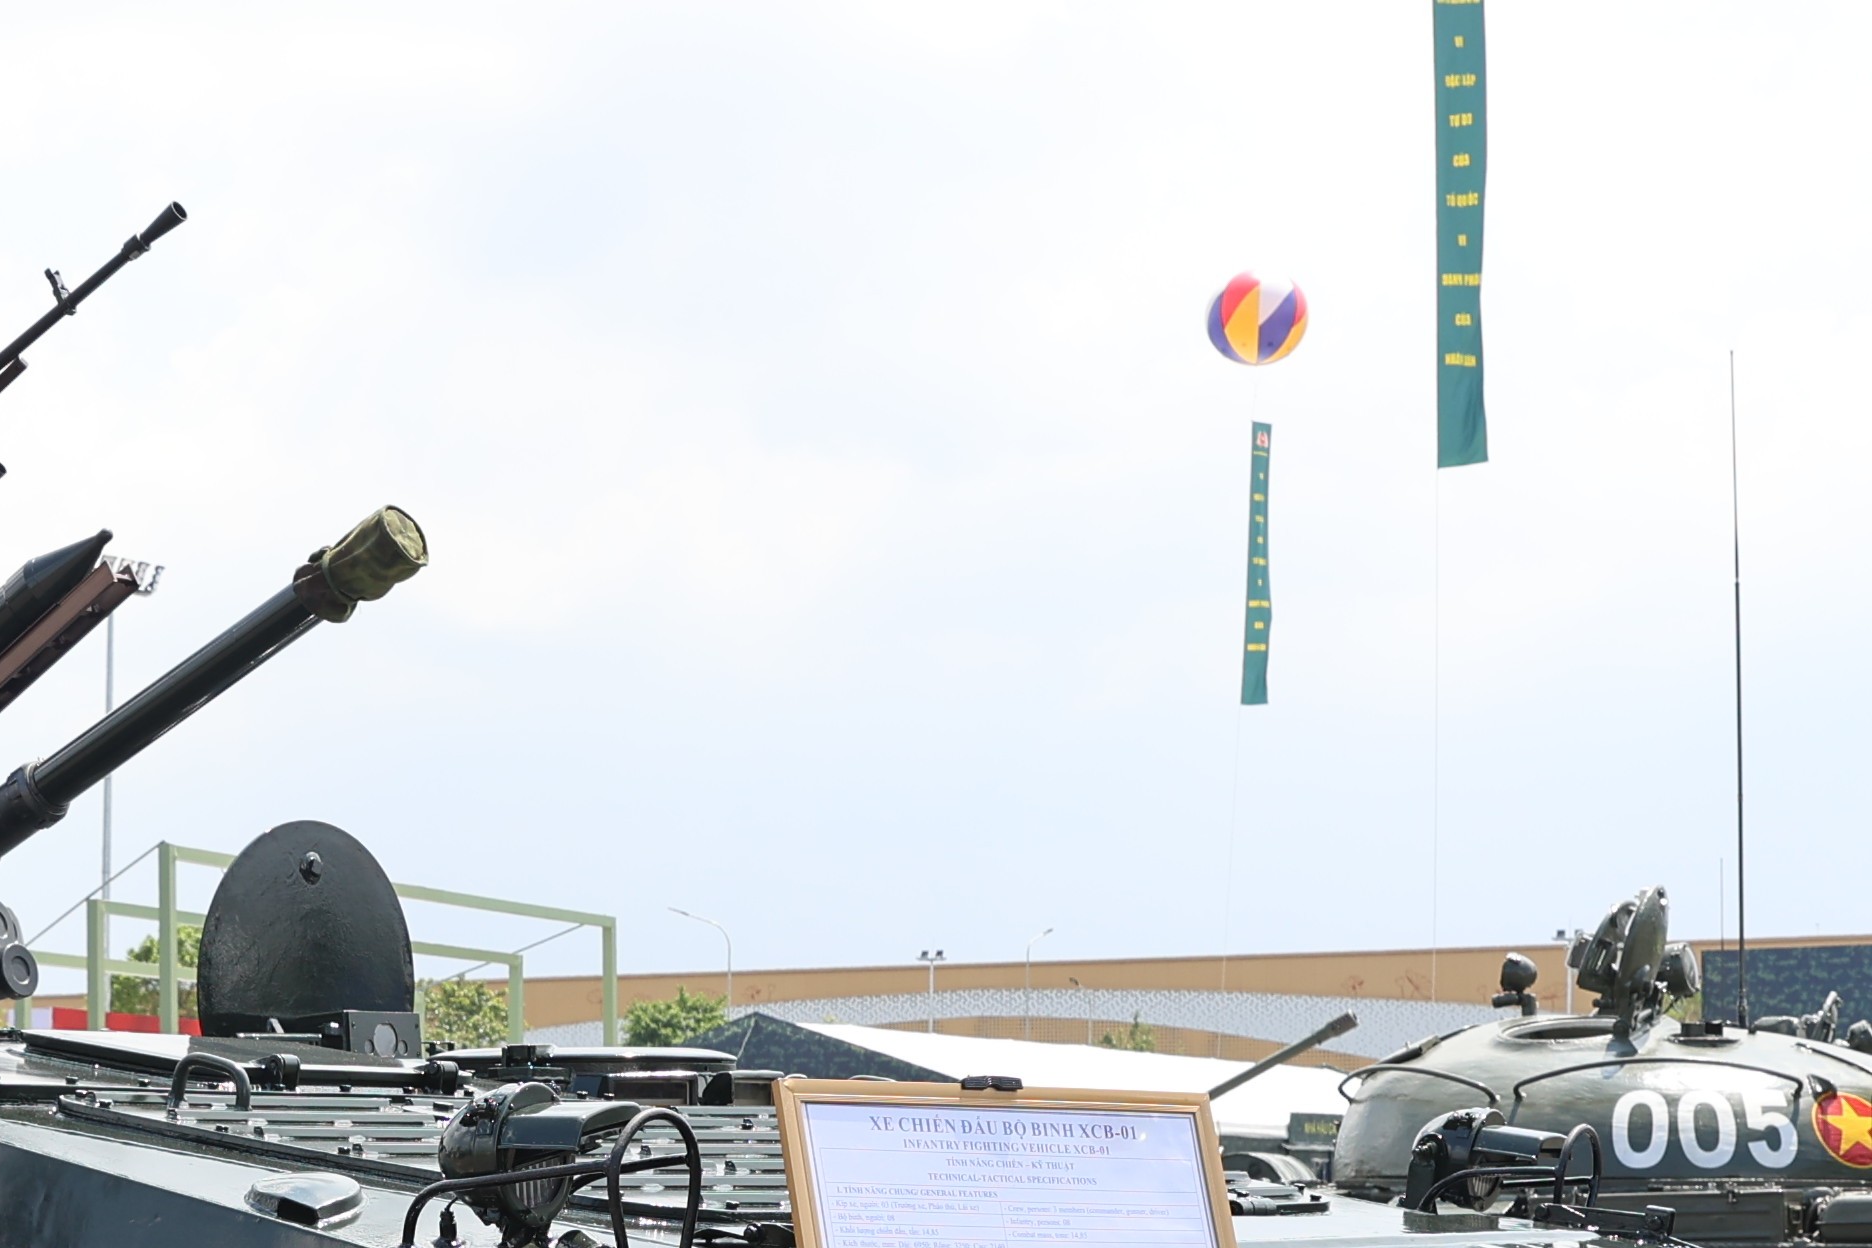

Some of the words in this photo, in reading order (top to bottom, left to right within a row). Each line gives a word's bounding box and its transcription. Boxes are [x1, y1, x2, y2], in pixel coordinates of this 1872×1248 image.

[869, 1116, 894, 1131] XE
[897, 1113, 957, 1133] CHIẾN
[959, 1116, 999, 1135] ĐẤU
[1001, 1117, 1028, 1139] BỘ
[1030, 1122, 1075, 1138] BINH
[1078, 1124, 1137, 1140] XCB-01
[1611, 1089, 1799, 1169] 005
[902, 1139, 962, 1150] INFANTRY
[962, 1141, 1020, 1152] FIGHTING
[1021, 1143, 1071, 1154] VEHICLE
[1072, 1144, 1110, 1155] XCB-01
[946, 1157, 968, 1167] TÍNH
[968, 1157, 995, 1168] NĂNG
[995, 1158, 1024, 1169] CHIẾN
[1030, 1159, 1044, 1169] KỸ
[1044, 1160, 1075, 1172] THUẬT
[927, 1173, 1026, 1183] TECHNICAL-TACTICAL
[1027, 1176, 1098, 1185] SPECIFICATIONS
